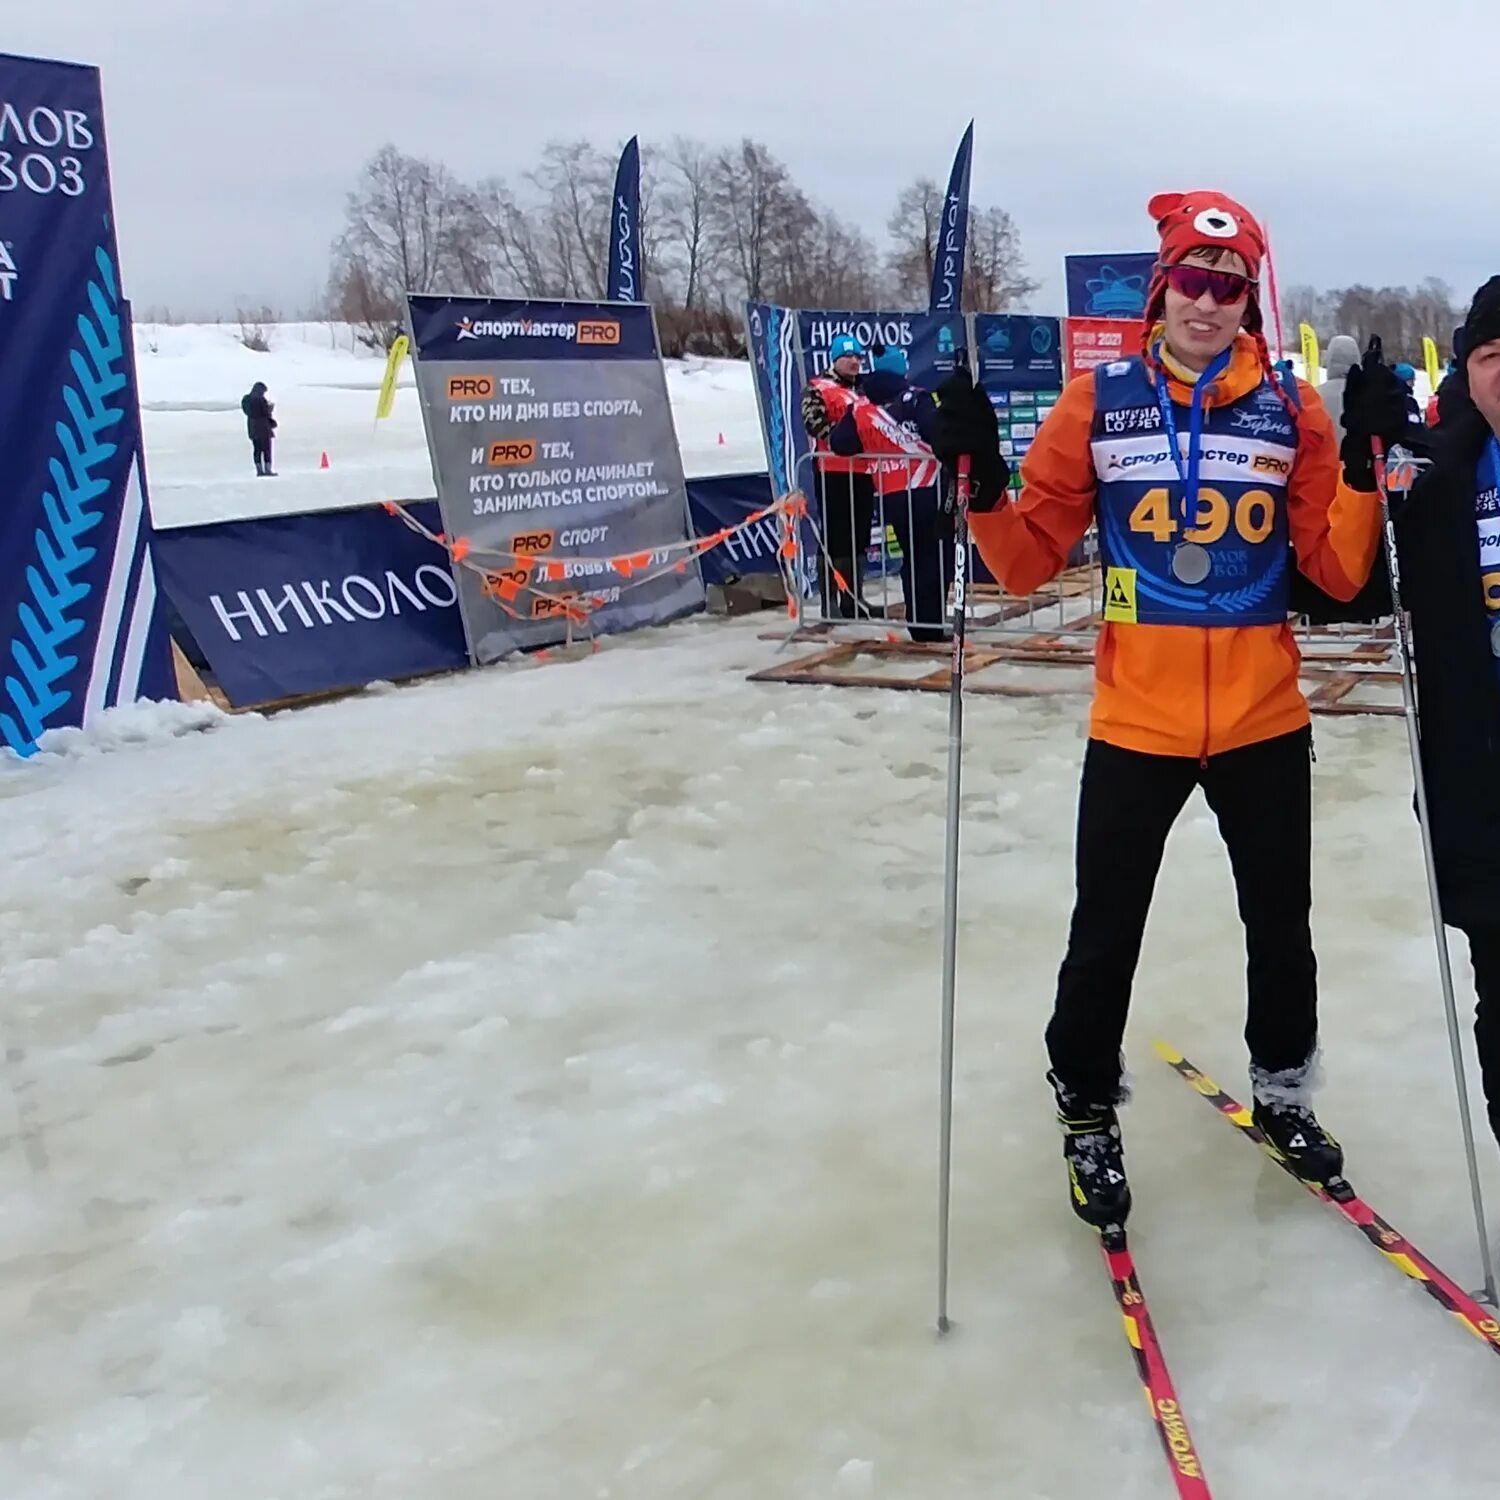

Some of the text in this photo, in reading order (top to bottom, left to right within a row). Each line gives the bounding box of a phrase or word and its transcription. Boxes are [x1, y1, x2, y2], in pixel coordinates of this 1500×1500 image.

[579, 324, 617, 341] PRO
[450, 378, 535, 396] PRO ТЕХ,
[450, 400, 643, 423] КТО НИ ДНЯ БЕЗ СПОРТА,
[471, 442, 575, 465] И PRO ТЕХ,
[1253, 455, 1290, 474] PRO
[469, 462, 655, 493] КТО ТОЛЬКО НАЧИНАЕТ
[473, 489, 582, 515] ЗАНИМАТЬСЯ
[1129, 487, 1275, 544] 490
[513, 526, 609, 553] PRO СПОРТ
[209, 564, 458, 641] НИКОЛО
[1156, 1397, 1200, 1479] ATOMIC
